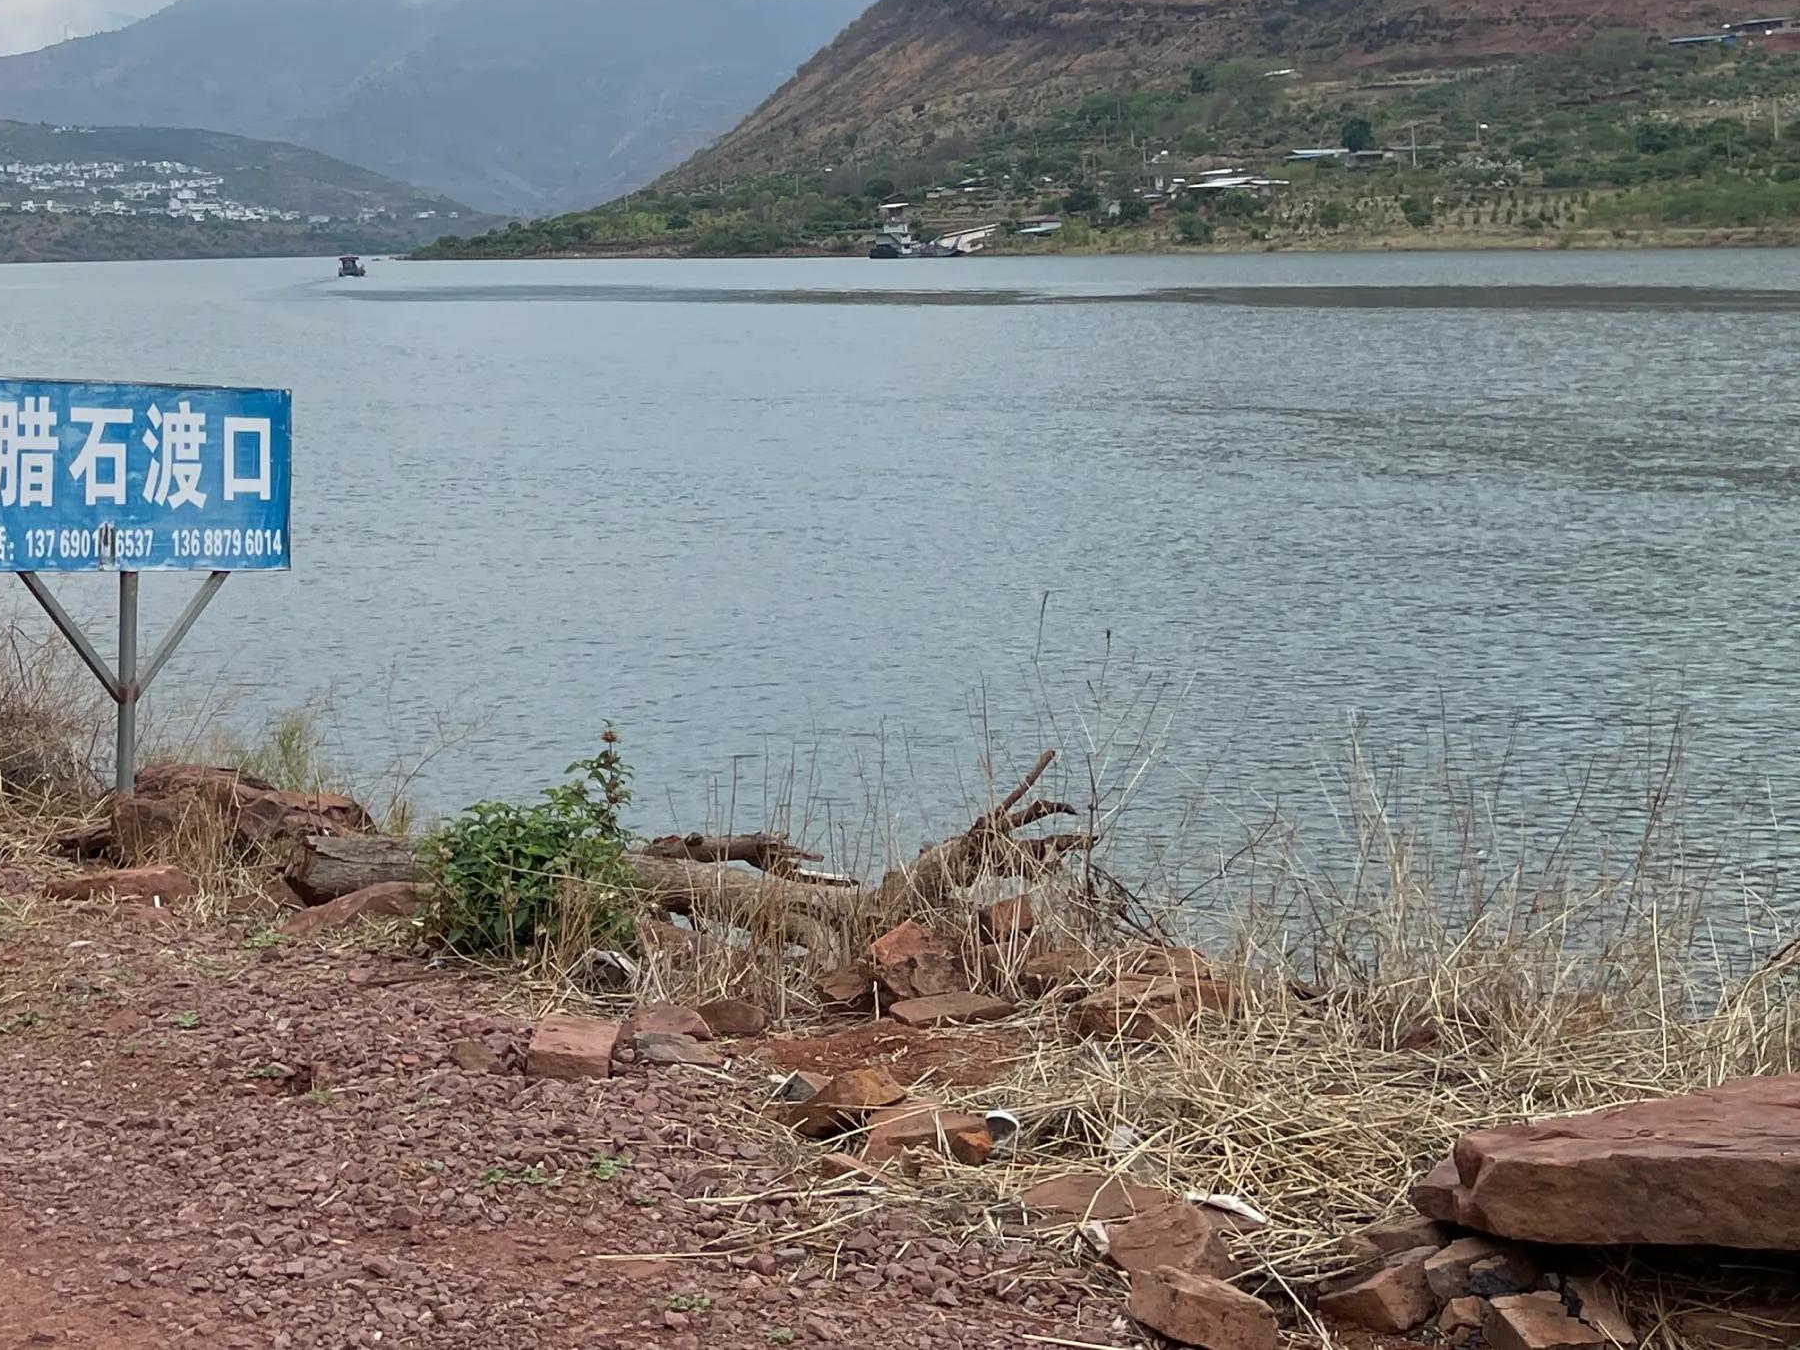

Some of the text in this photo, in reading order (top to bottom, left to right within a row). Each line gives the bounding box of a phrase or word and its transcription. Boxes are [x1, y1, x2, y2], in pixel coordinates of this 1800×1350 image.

[25, 529, 55, 558] 137
[59, 529, 100, 558] 6901
[115, 529, 153, 558] 6537
[172, 529, 201, 557] 136
[203, 529, 242, 557] 8879
[245, 529, 282, 556] 6014
